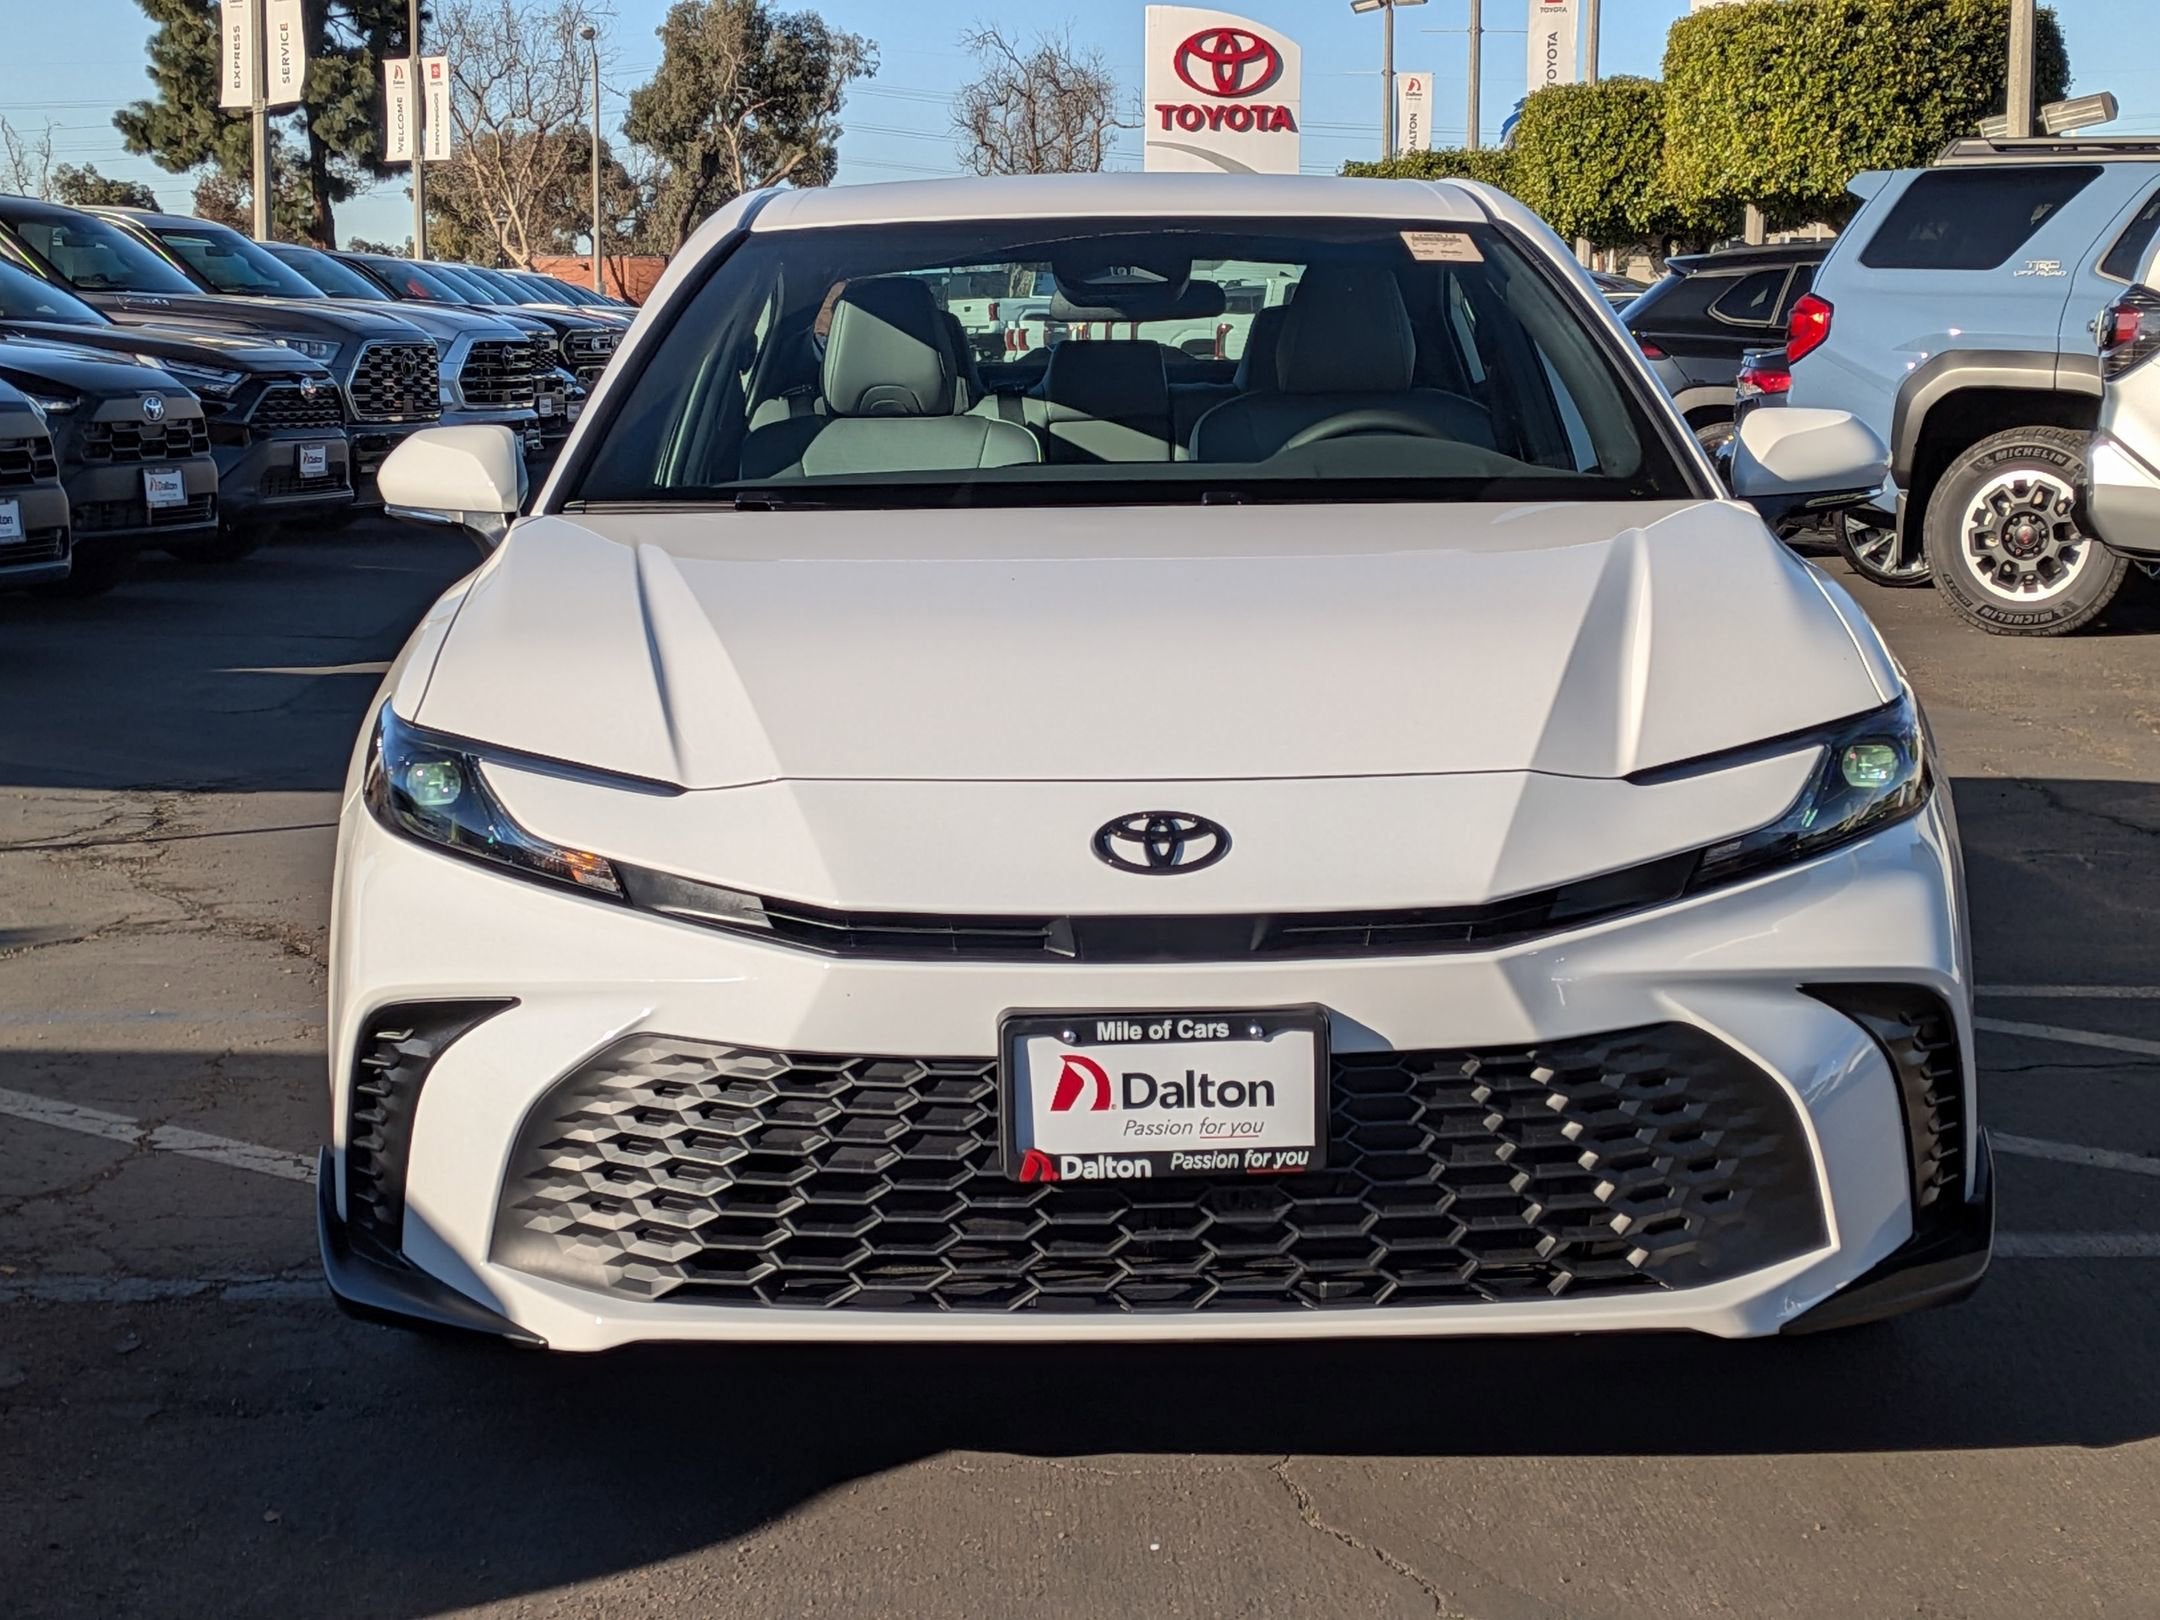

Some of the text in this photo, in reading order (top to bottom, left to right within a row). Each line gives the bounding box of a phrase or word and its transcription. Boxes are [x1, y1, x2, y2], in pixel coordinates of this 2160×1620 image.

[233, 25, 241, 88] EXPRESS
[280, 22, 290, 84] SERVICE
[1154, 104, 1298, 133] TOYOTA
[1995, 447, 2067, 465] MICHELIN
[1980, 606, 2053, 624] MICHELIN
[1097, 1019, 1230, 1041] Mile of Cars
[1122, 1070, 1275, 1110] Dalton
[1123, 1117, 1265, 1138] Passion for you
[1060, 1155, 1153, 1181] Dalton
[1170, 1150, 1309, 1171] Passion for you
